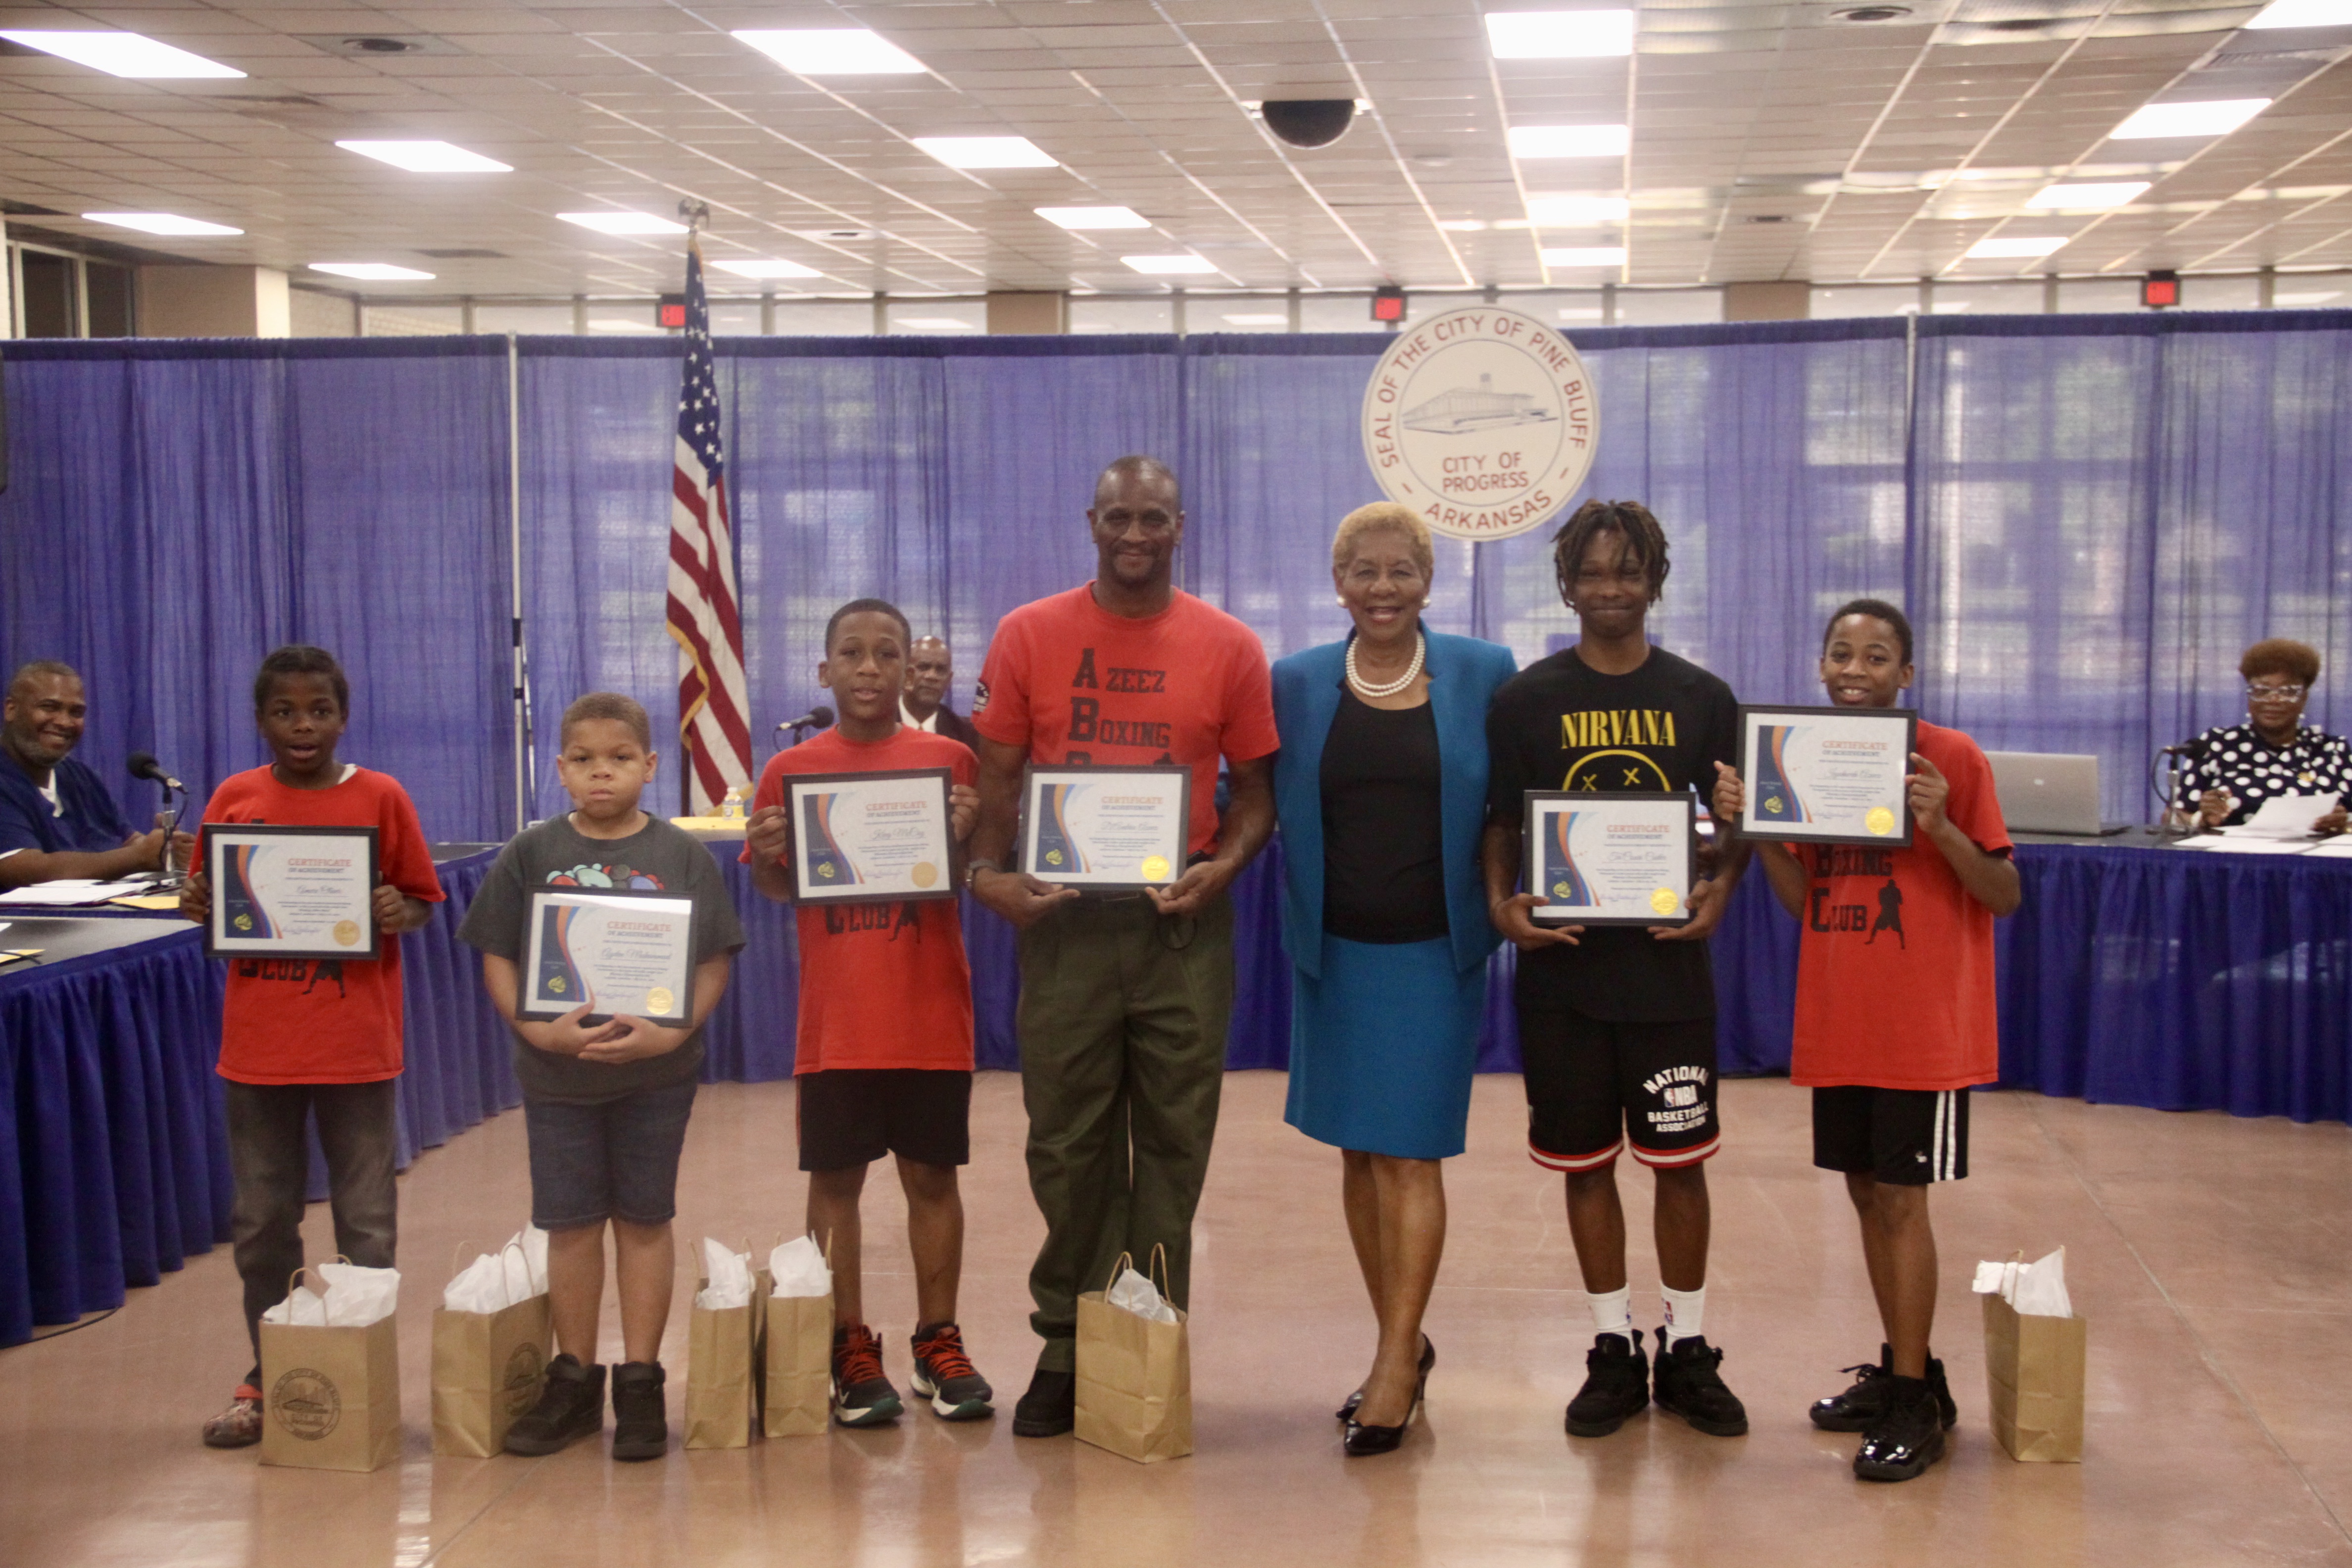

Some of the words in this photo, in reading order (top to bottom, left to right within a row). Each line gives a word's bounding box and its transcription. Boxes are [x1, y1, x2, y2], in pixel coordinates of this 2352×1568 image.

[1435, 315, 1484, 341] CITY
[1494, 317, 1524, 338] OF
[1392, 335, 1431, 370] THE
[1529, 332, 1570, 373] PINE
[1377, 375, 1399, 403] OF
[1564, 380, 1588, 449] BLUFF
[1374, 412, 1400, 467] SEAL
[1442, 455, 1486, 473] CITY
[1499, 452, 1521, 469] OF
[1442, 471, 1529, 493] PROGRESS
[1425, 490, 1551, 530] ARKANSAS
[1068, 696, 1172, 749] BOXING
[1561, 709, 1676, 749] NIRVANA
[1822, 740, 1888, 750] CERTIFICATE
[866, 801, 927, 811] CERTIFICATE
[288, 858, 352, 867] CERTIFICATE
[607, 921, 671, 931] CERTIFICATE
